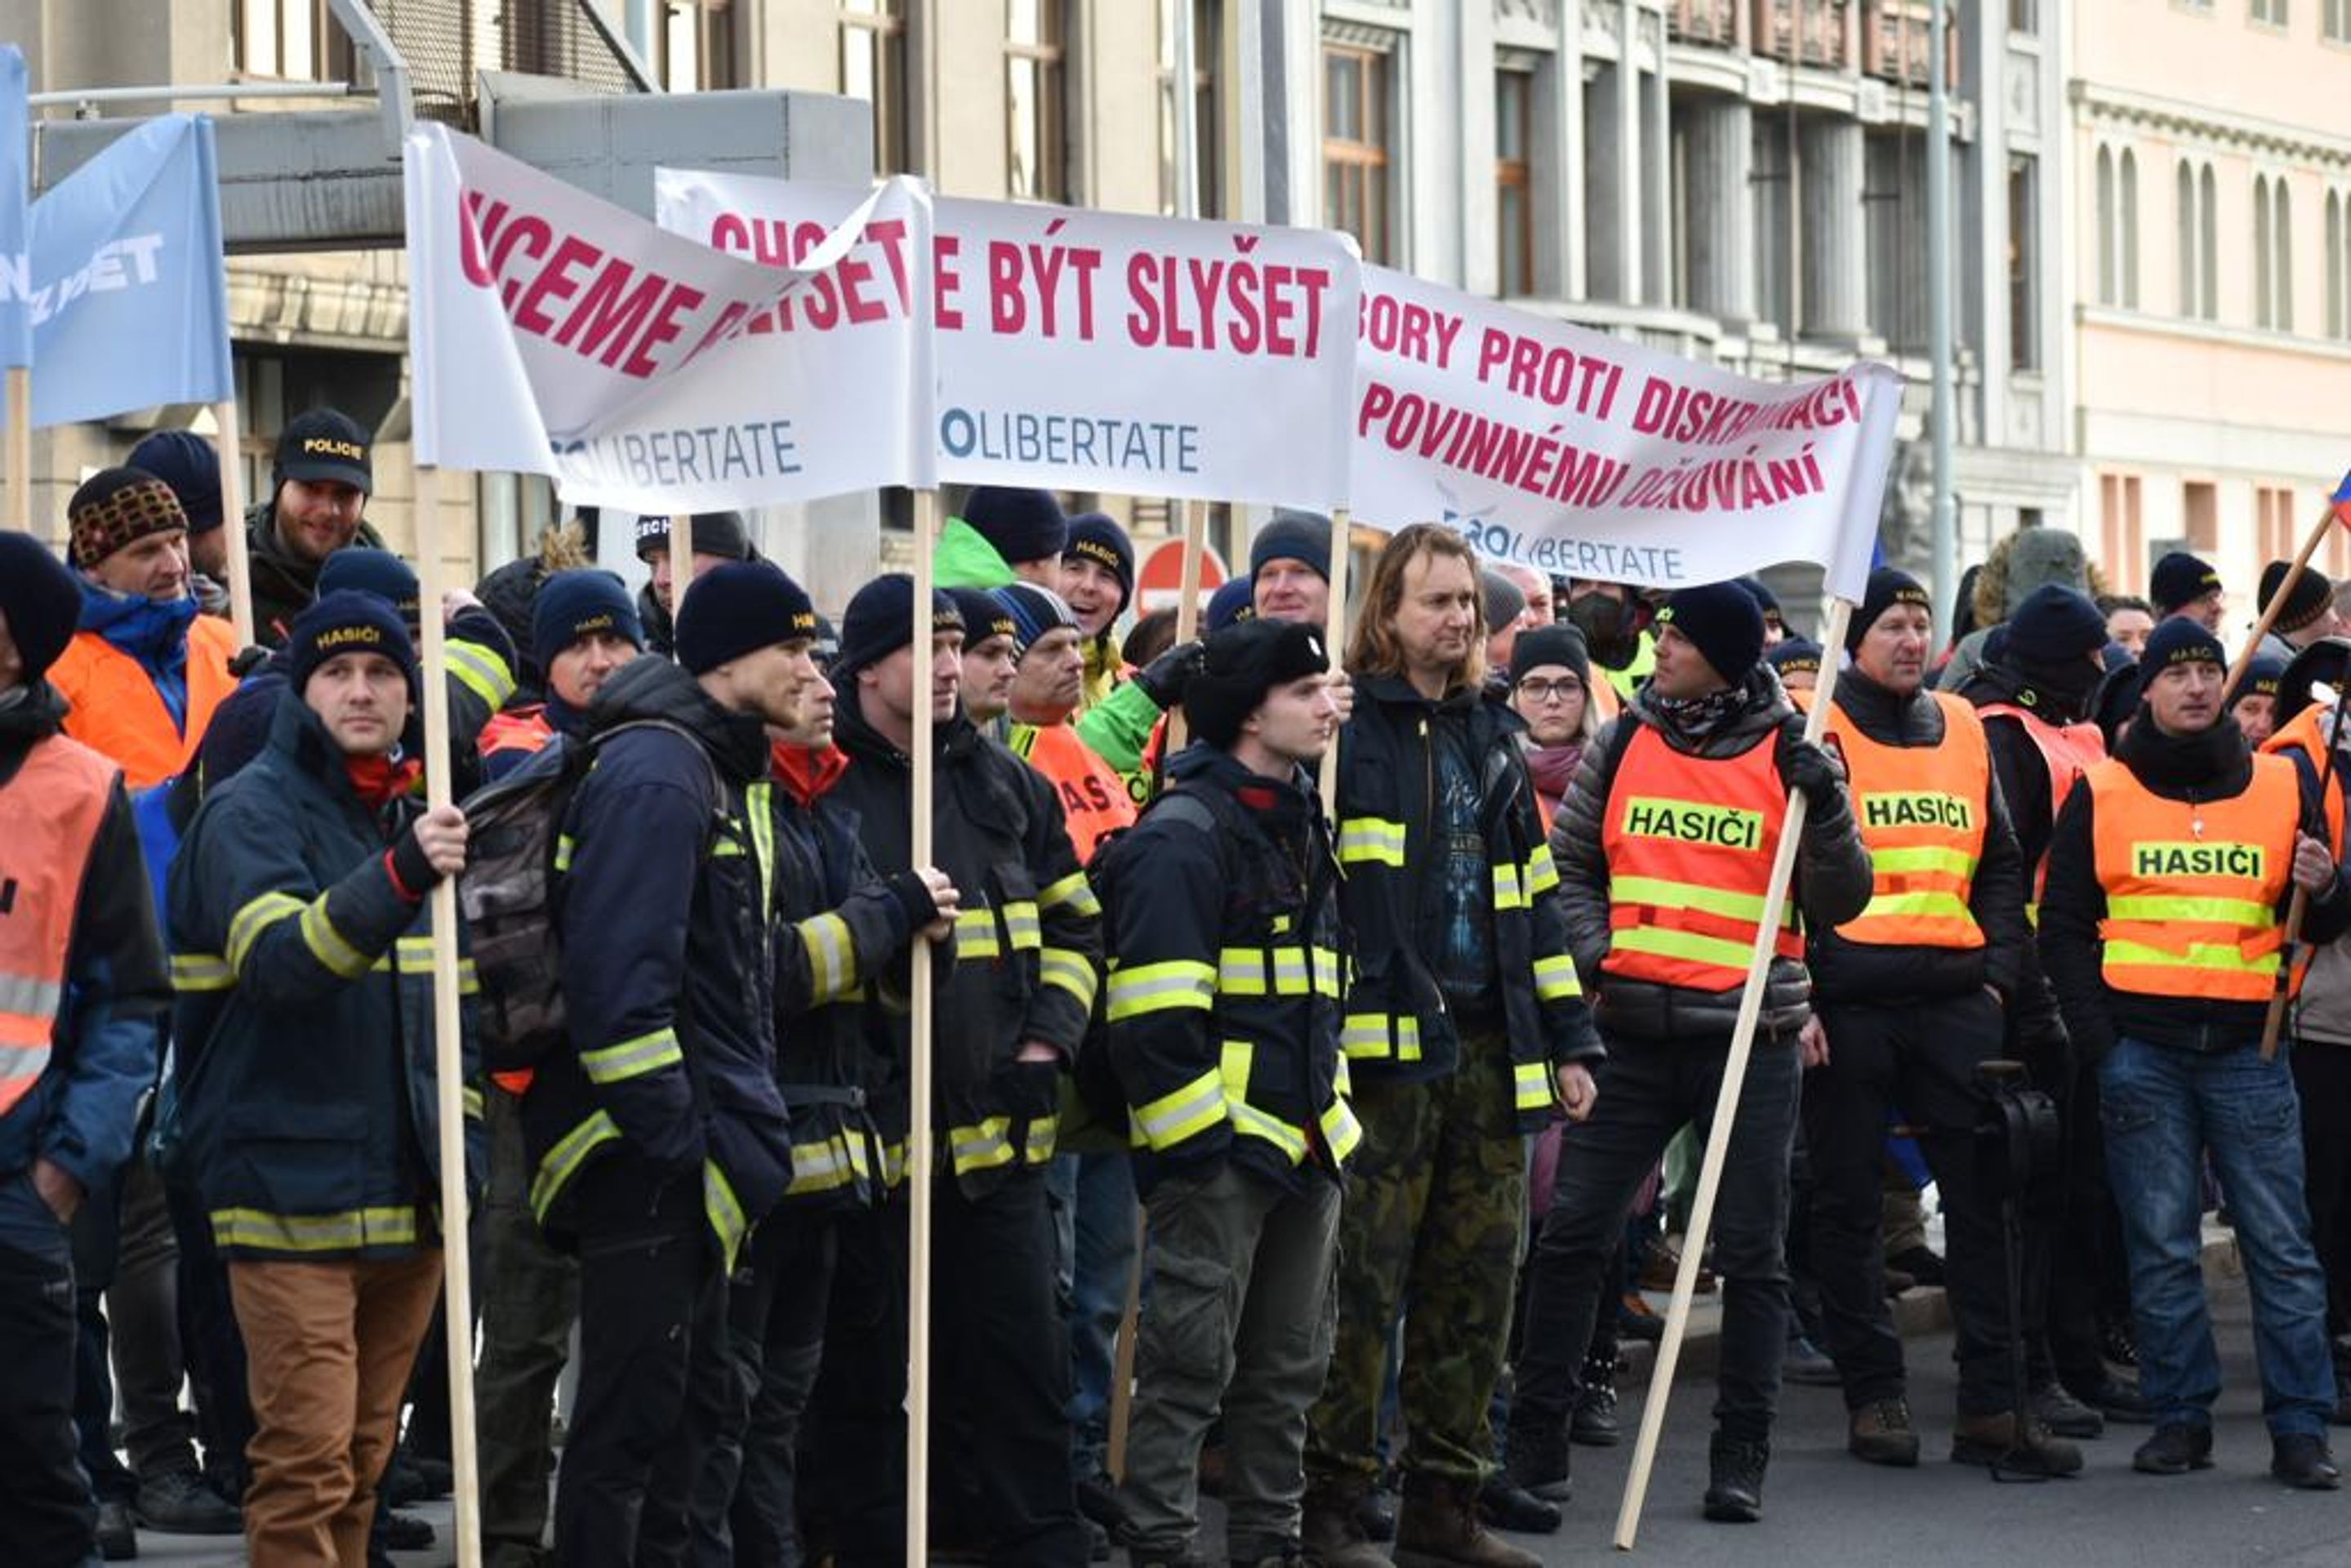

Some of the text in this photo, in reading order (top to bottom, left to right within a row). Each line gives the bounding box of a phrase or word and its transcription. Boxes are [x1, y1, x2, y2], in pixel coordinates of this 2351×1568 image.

[989, 218, 1101, 341] BÝT
[1127, 234, 1329, 359] SLYŠET
[1477, 327, 1624, 421] PROTI
[1358, 381, 1631, 509] POVINNÉMU
[316, 625, 381, 651] HASIČI
[1628, 804, 1757, 849] HASIČI
[1866, 790, 1969, 829] HASIČI
[2137, 844, 2261, 878] HASIČI
